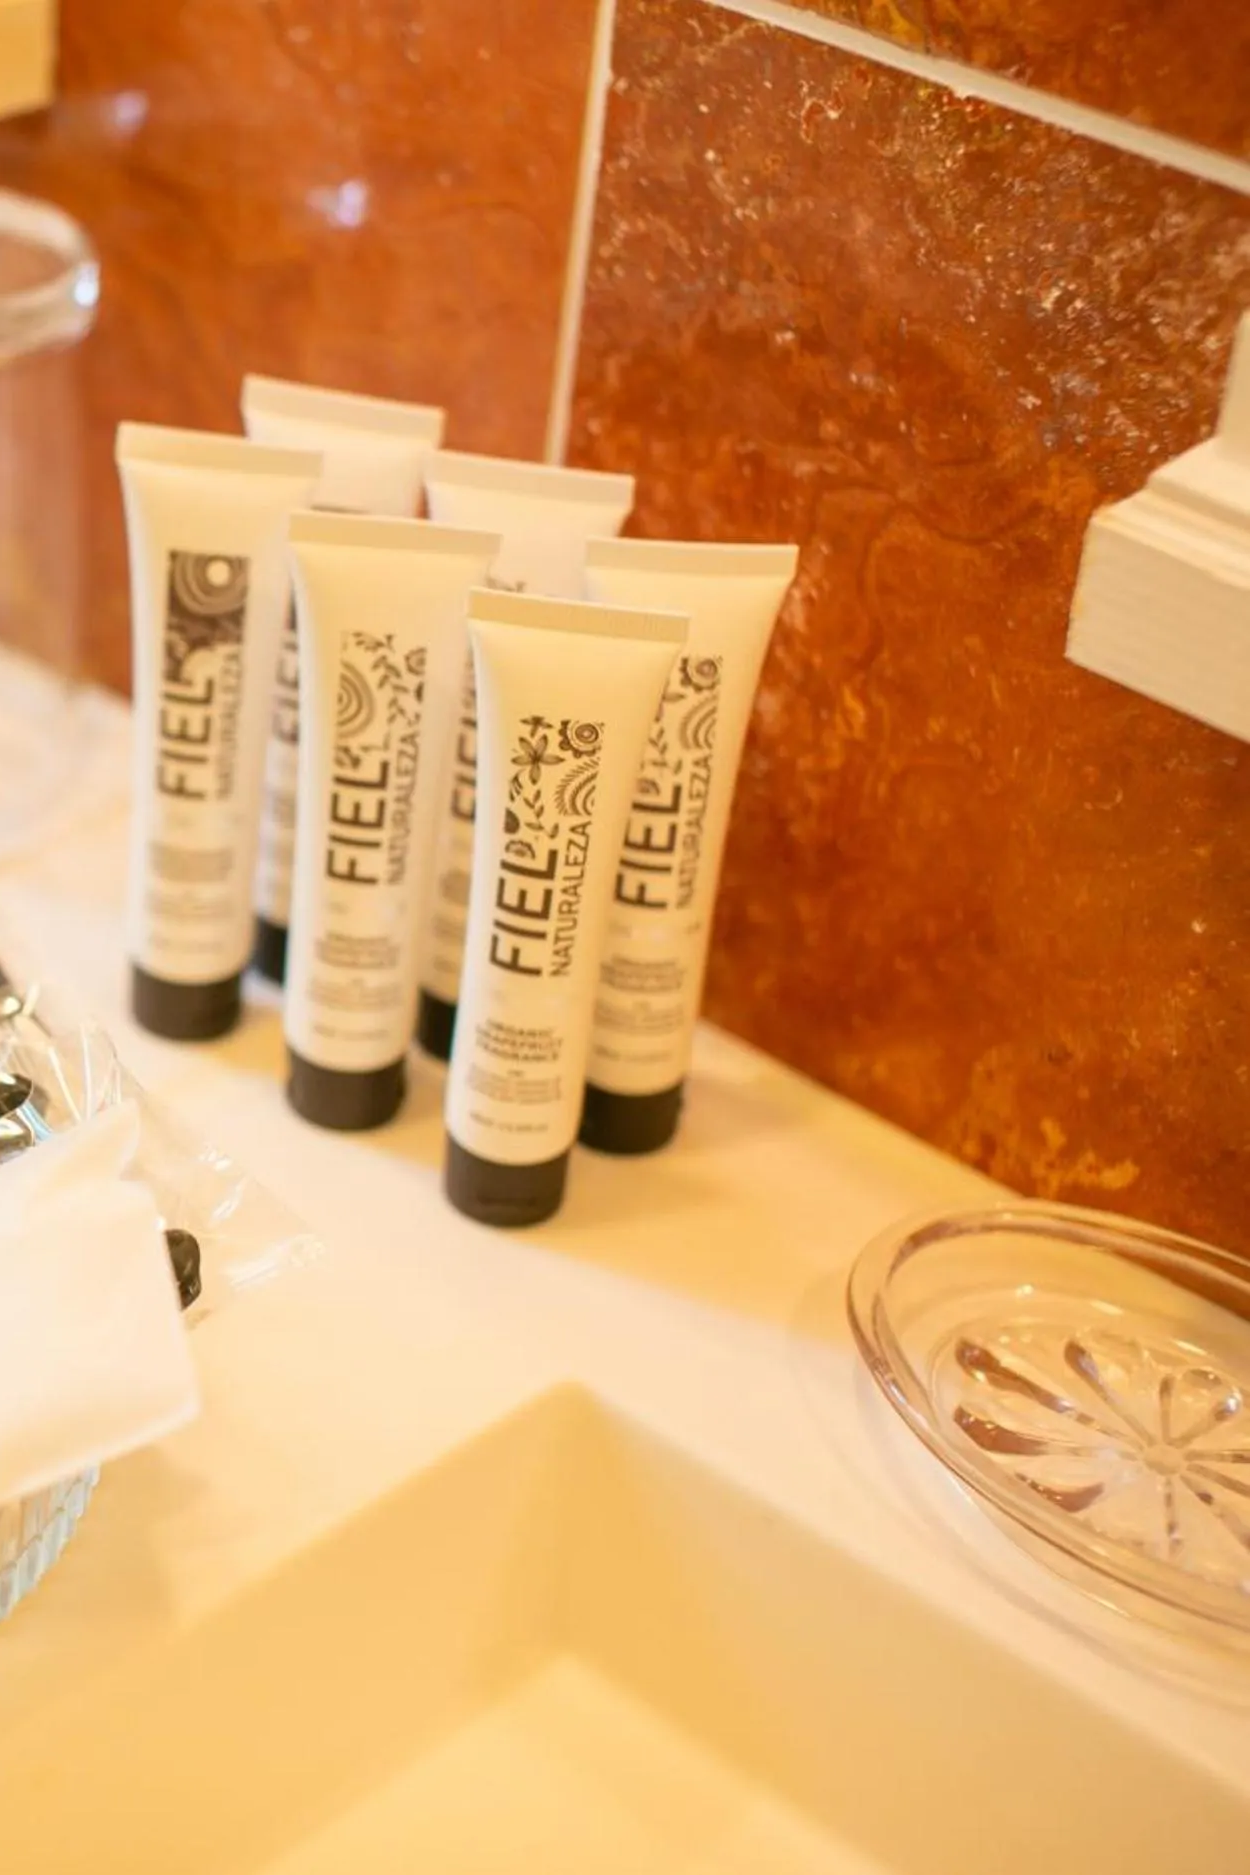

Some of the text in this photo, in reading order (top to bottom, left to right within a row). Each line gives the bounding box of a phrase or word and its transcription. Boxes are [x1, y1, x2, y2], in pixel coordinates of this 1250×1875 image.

[158, 678, 215, 802] FIEL
[325, 758, 390, 886] FIEL
[387, 731, 420, 886] NATURALEZA
[615, 783, 682, 910] FIEL
[676, 755, 713, 910] NATURALEZA
[489, 849, 558, 978] FIEL
[550, 820, 593, 978] NATURALEZA
